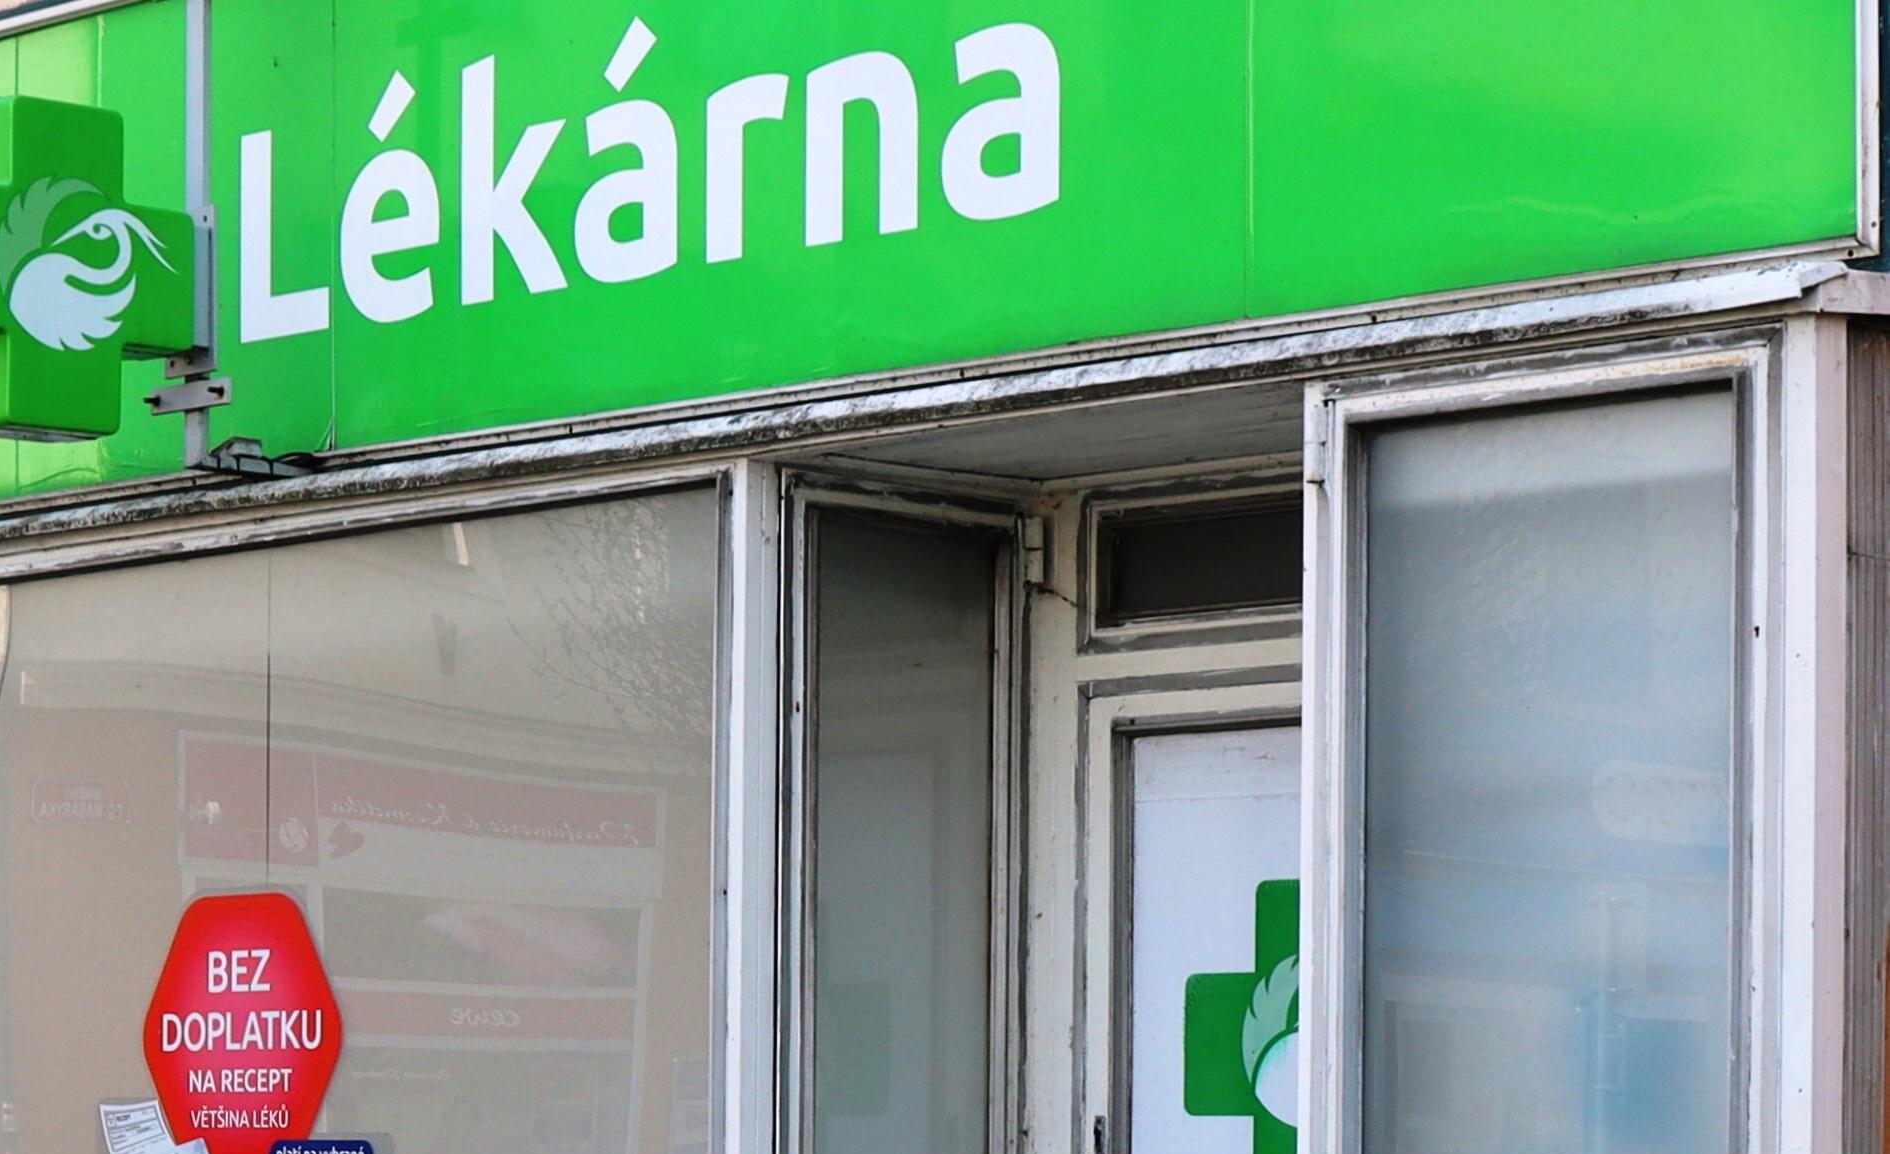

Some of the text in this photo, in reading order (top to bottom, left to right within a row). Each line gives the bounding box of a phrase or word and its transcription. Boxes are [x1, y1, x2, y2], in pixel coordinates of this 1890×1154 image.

[239, 14, 1061, 344] Lékárna
[208, 949, 271, 993] BEZ
[162, 1009, 322, 1052] DOPLATKU
[189, 1068, 293, 1093] NA RECEPT
[190, 1103, 289, 1129] VĚTŠINA LÉKŮ
